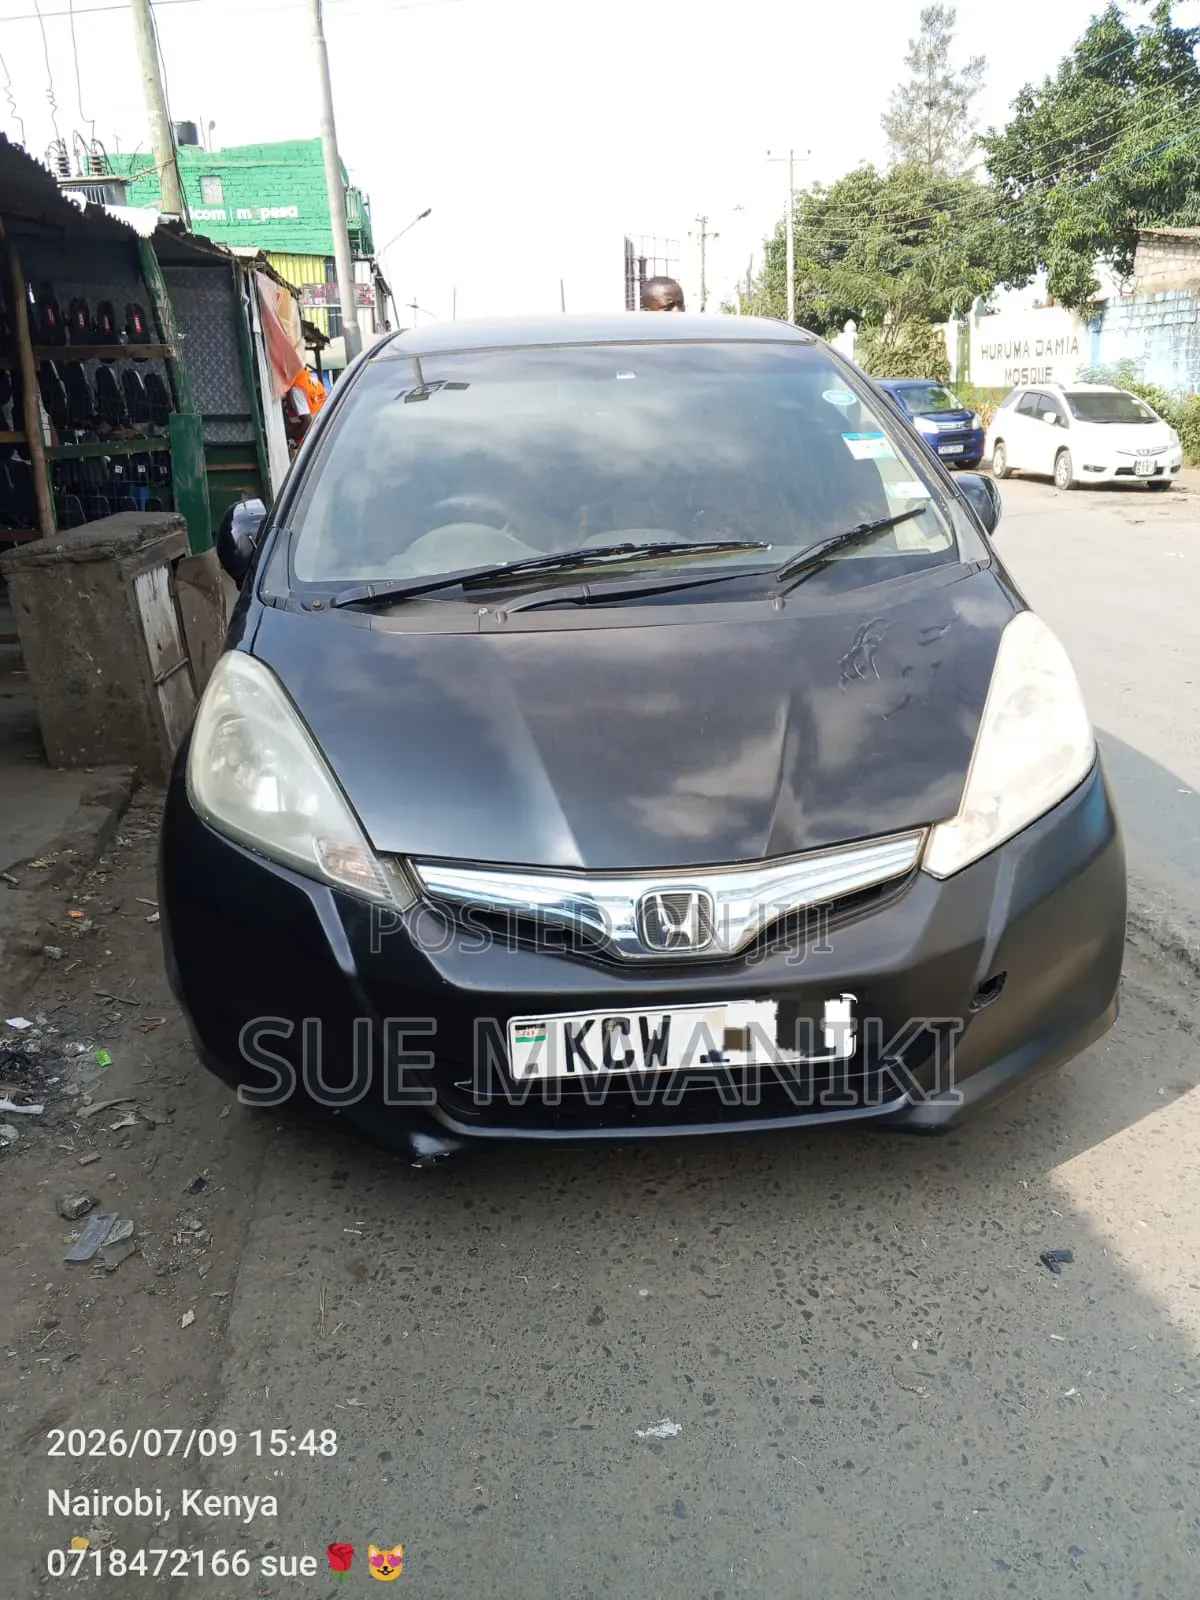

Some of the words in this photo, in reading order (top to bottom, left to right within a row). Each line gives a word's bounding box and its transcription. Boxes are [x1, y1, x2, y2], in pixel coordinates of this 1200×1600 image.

[980, 340, 1031, 361] HURUMA
[1035, 335, 1080, 357] JAMIA
[1004, 366, 1054, 387] MOSQUE
[563, 1015, 672, 1073] KCW
